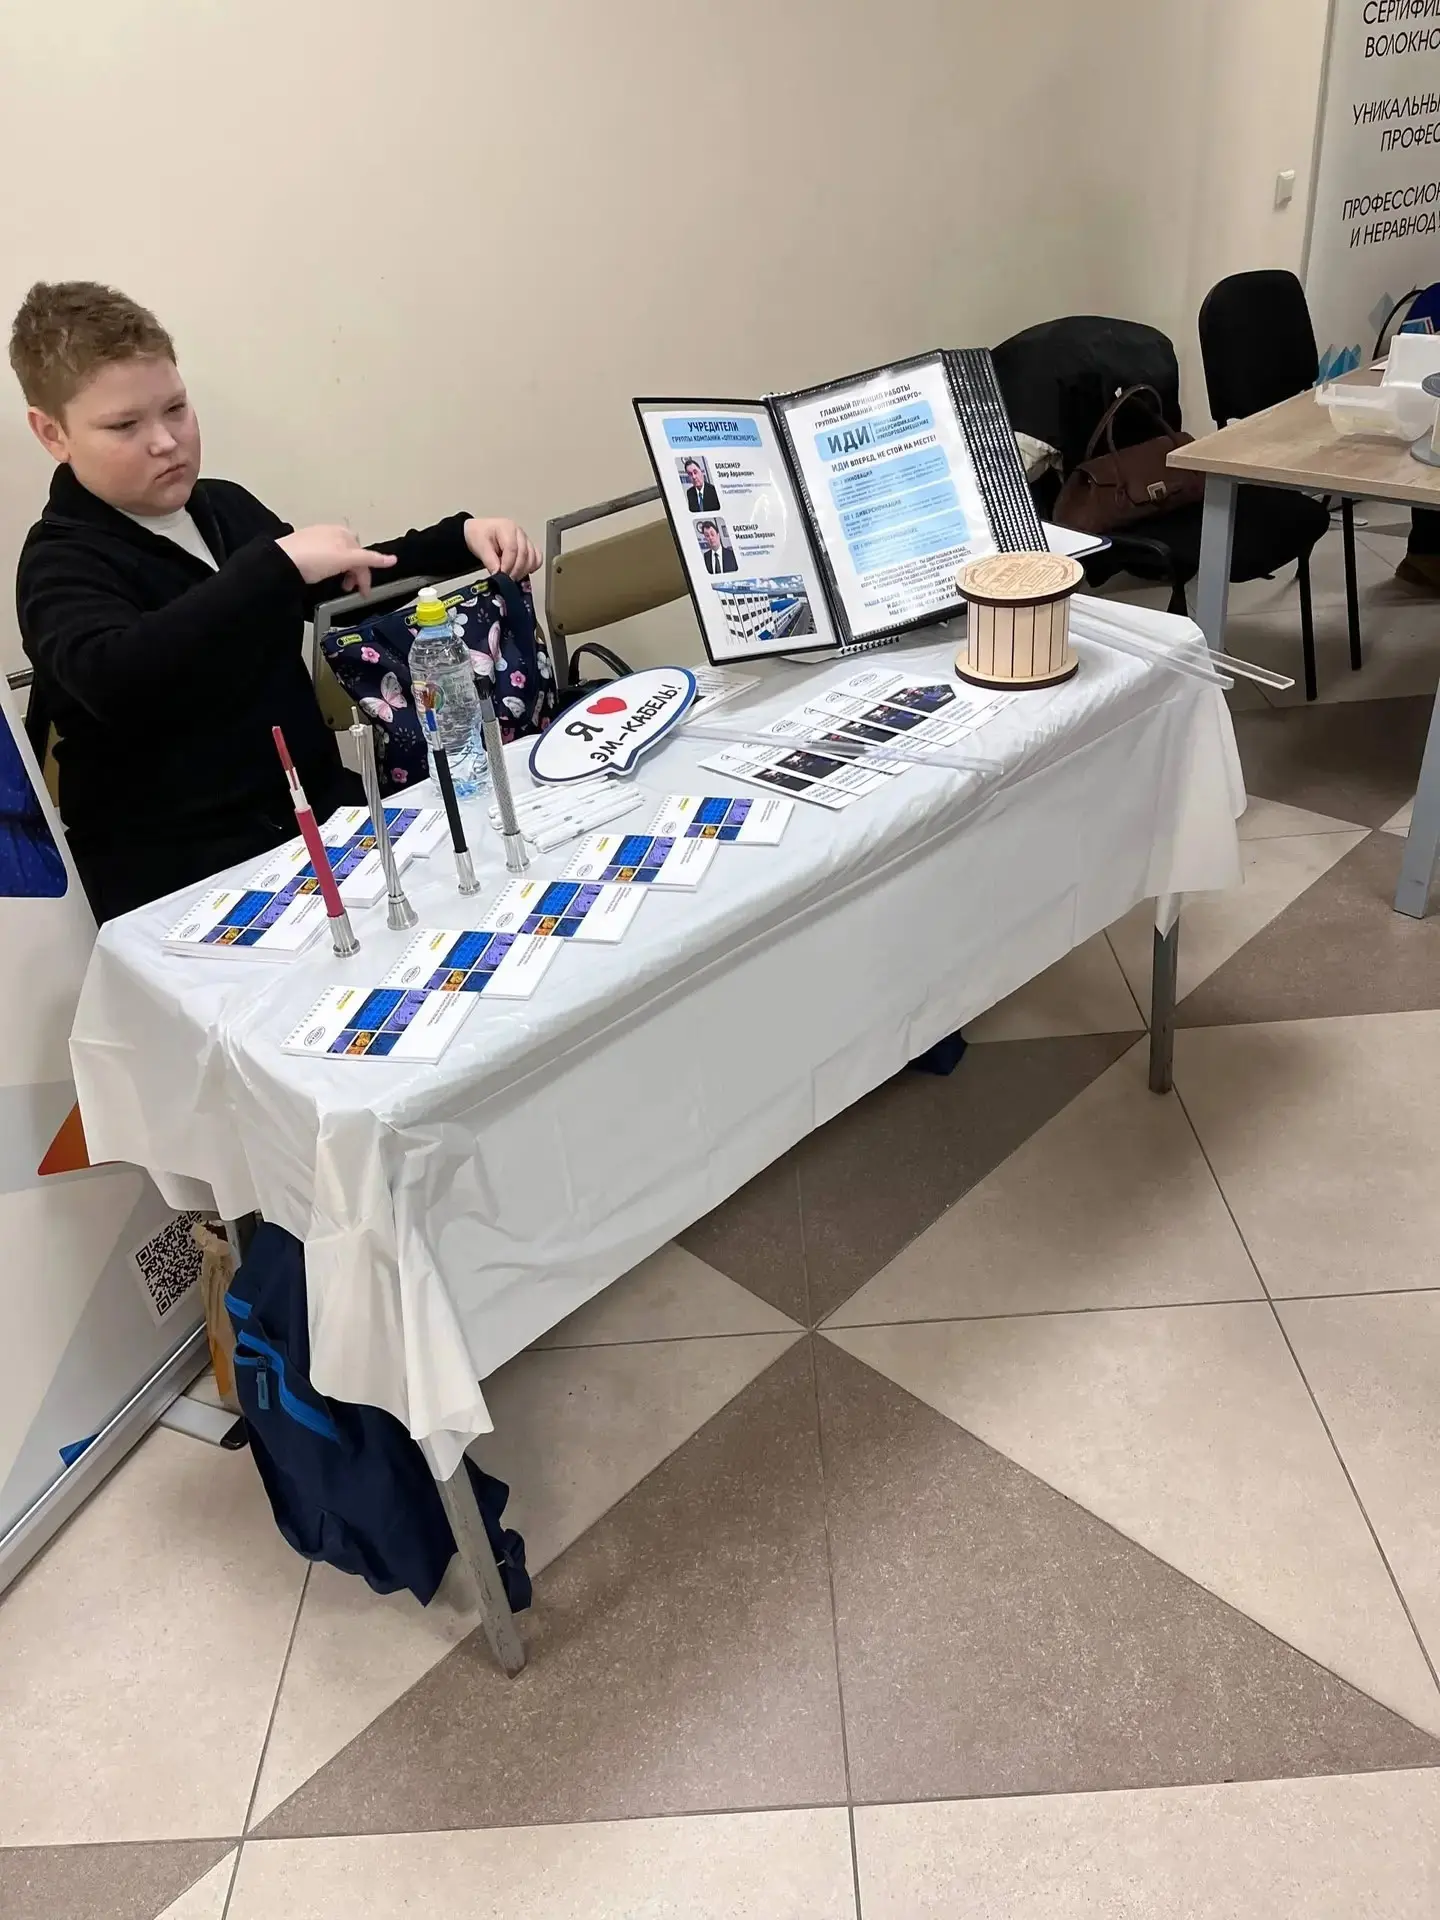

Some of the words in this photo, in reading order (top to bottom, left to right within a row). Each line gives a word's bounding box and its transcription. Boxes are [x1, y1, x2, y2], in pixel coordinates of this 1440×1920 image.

[1350, 226, 1361, 248] И
[1363, 210, 1440, 245] НЕРАВНОД
[819, 401, 852, 418] ГЛАВНЫЙ
[884, 384, 912, 398] РАБОТЫ
[687, 421, 739, 432] УЧРЕДИТЕЛИ
[814, 416, 840, 429] ГРУППЫ
[826, 425, 872, 457] ИДИ
[831, 460, 850, 473] ИДИ
[877, 450, 886, 459] НЕ
[885, 443, 903, 456] СТОЙ
[903, 442, 913, 450] НА
[913, 434, 937, 447] МЕСТЕ!
[564, 721, 604, 742] Я
